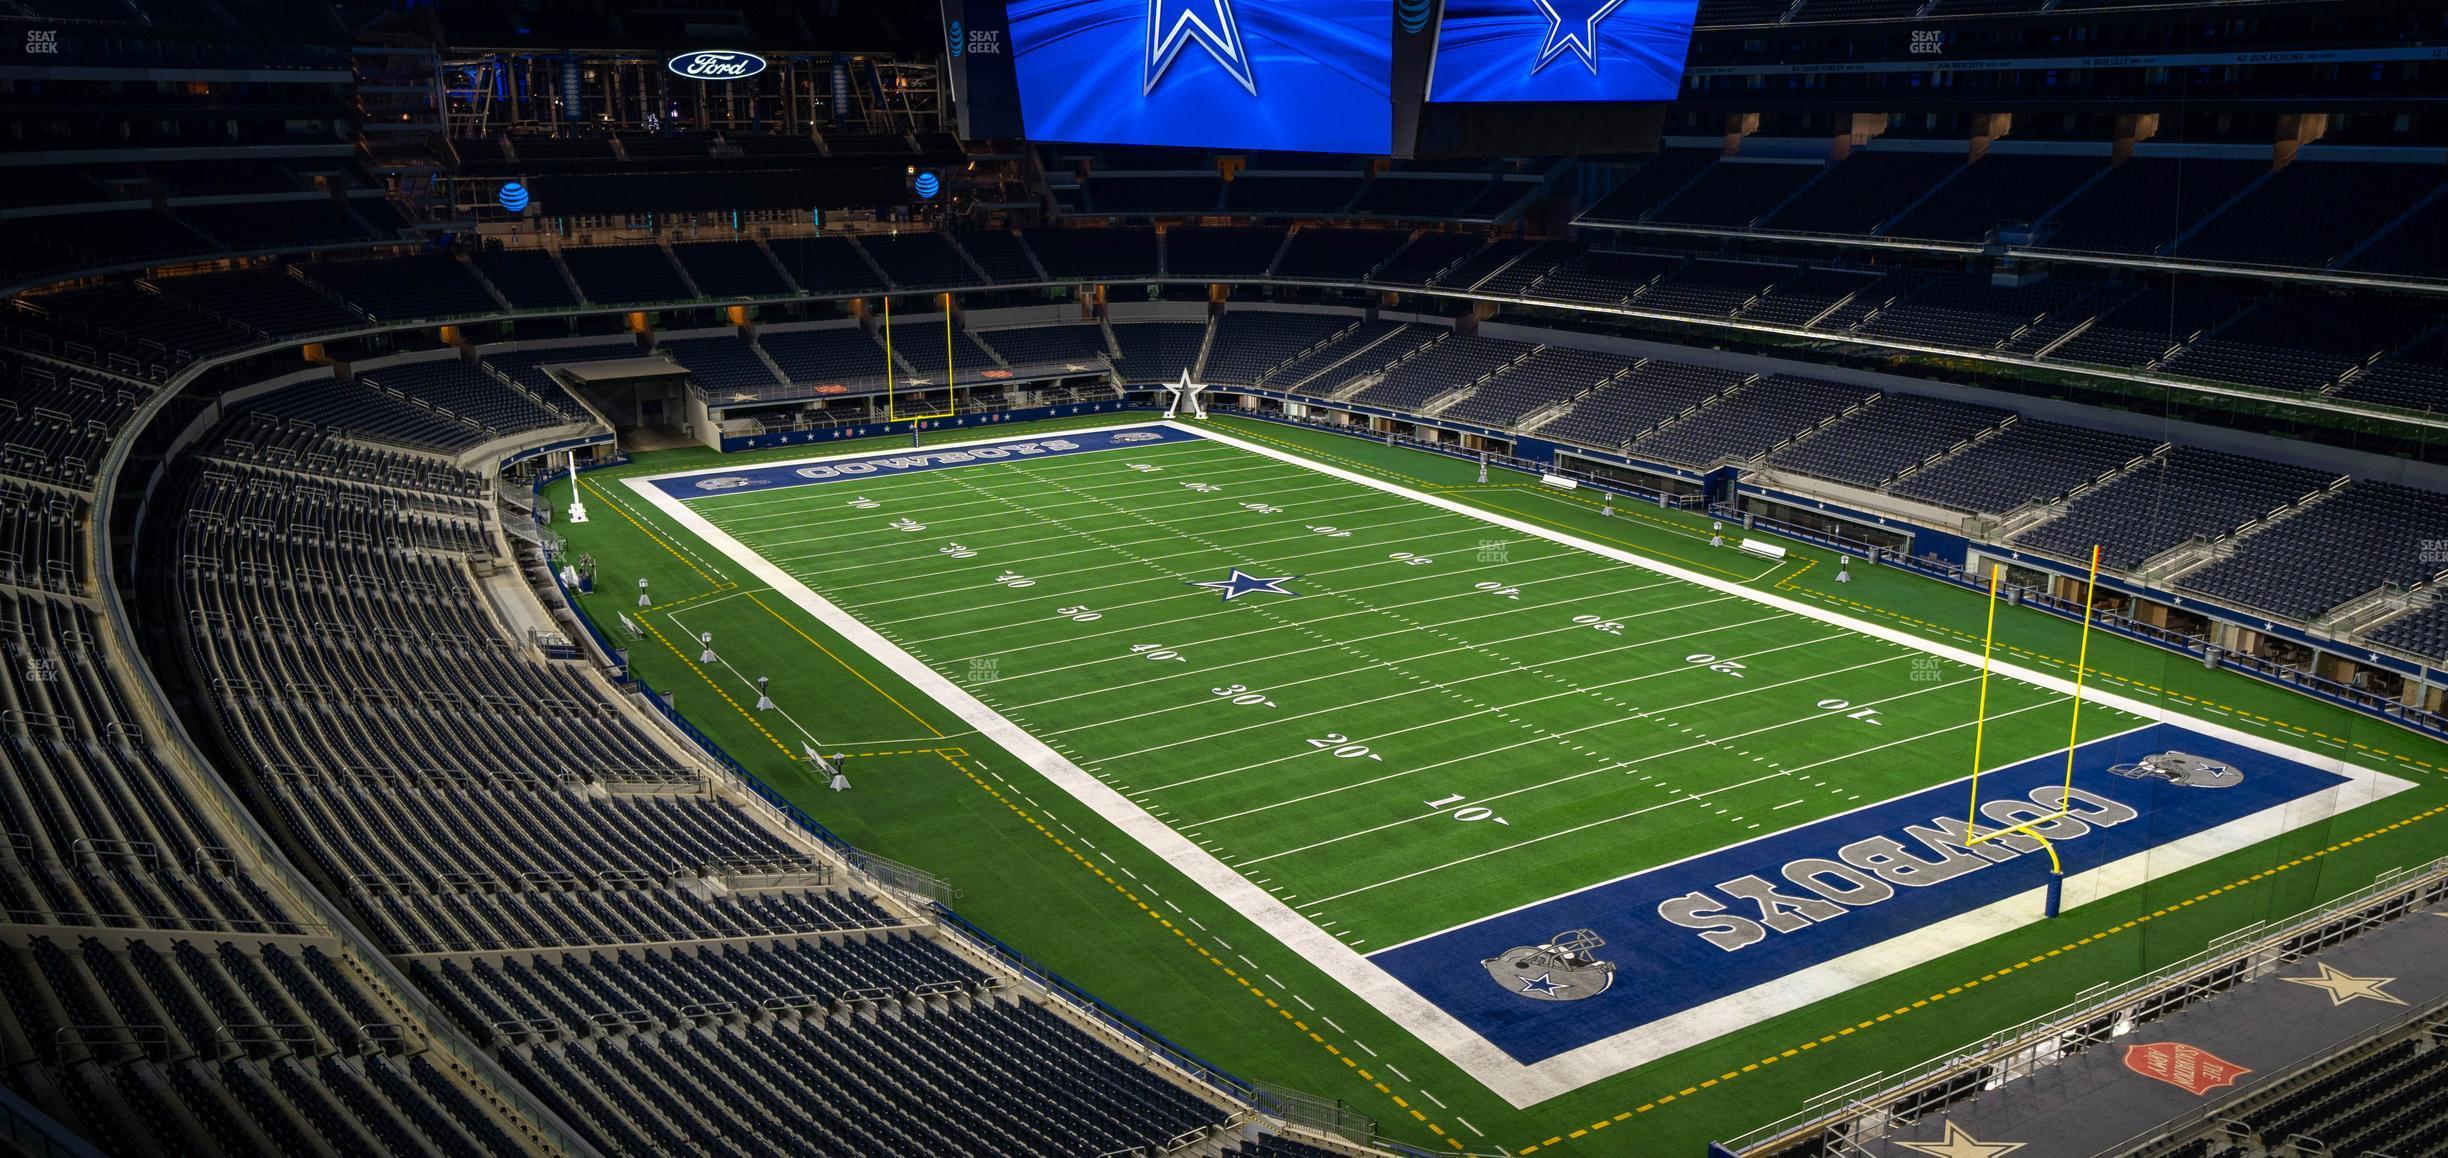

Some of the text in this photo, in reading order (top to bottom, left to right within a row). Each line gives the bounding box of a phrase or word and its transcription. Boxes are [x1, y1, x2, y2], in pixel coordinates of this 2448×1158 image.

[687, 54, 748, 75] Ford
[796, 439, 1080, 479] COWBOYS
[1389, 551, 1432, 565] 50
[995, 575, 1036, 587] 40
[1475, 581, 1520, 595] 40
[1057, 605, 1103, 621] 50
[1572, 615, 1625, 631] 30
[1129, 644, 1178, 660] 40
[1685, 654, 1747, 673] 20
[1211, 684, 1266, 705] 30
[1817, 699, 1882, 720] 10
[1306, 733, 1370, 758] 20
[1423, 793, 1493, 821] 10
[1656, 785, 2138, 952] COWBOYS
[2144, 1046, 2169, 1077] ARMY
[2174, 1045, 2198, 1090] SALVATION
[2203, 1061, 2223, 1082] THE
